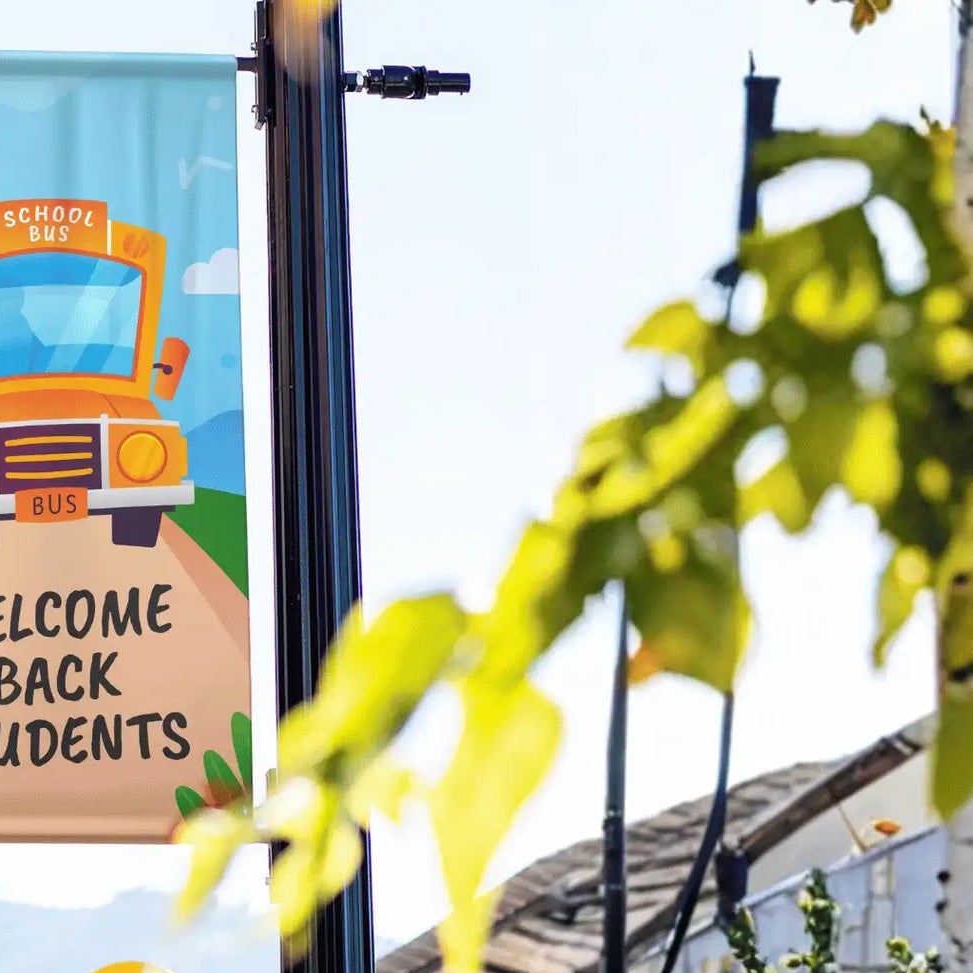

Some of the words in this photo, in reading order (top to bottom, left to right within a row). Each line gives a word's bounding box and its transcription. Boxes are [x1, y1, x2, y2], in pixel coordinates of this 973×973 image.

[3, 205, 94, 228] SCHOOL
[29, 225, 70, 242] BUS
[32, 493, 77, 516] BUS
